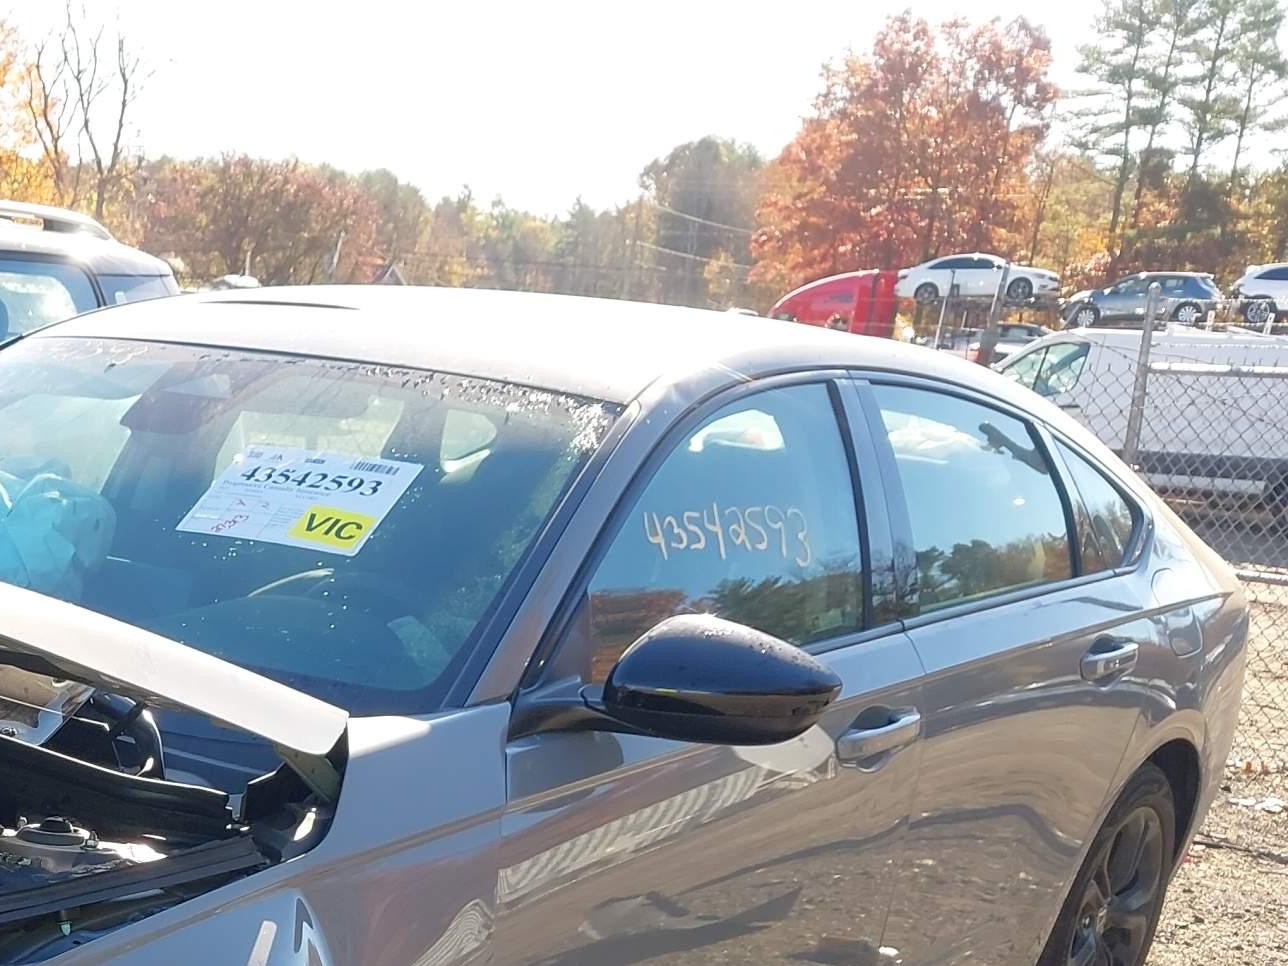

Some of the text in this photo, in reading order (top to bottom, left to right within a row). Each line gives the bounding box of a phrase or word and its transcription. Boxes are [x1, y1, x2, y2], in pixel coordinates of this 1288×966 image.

[240, 465, 384, 497] 43542593
[305, 512, 363, 541] VIC
[643, 501, 811, 567] 43542593
